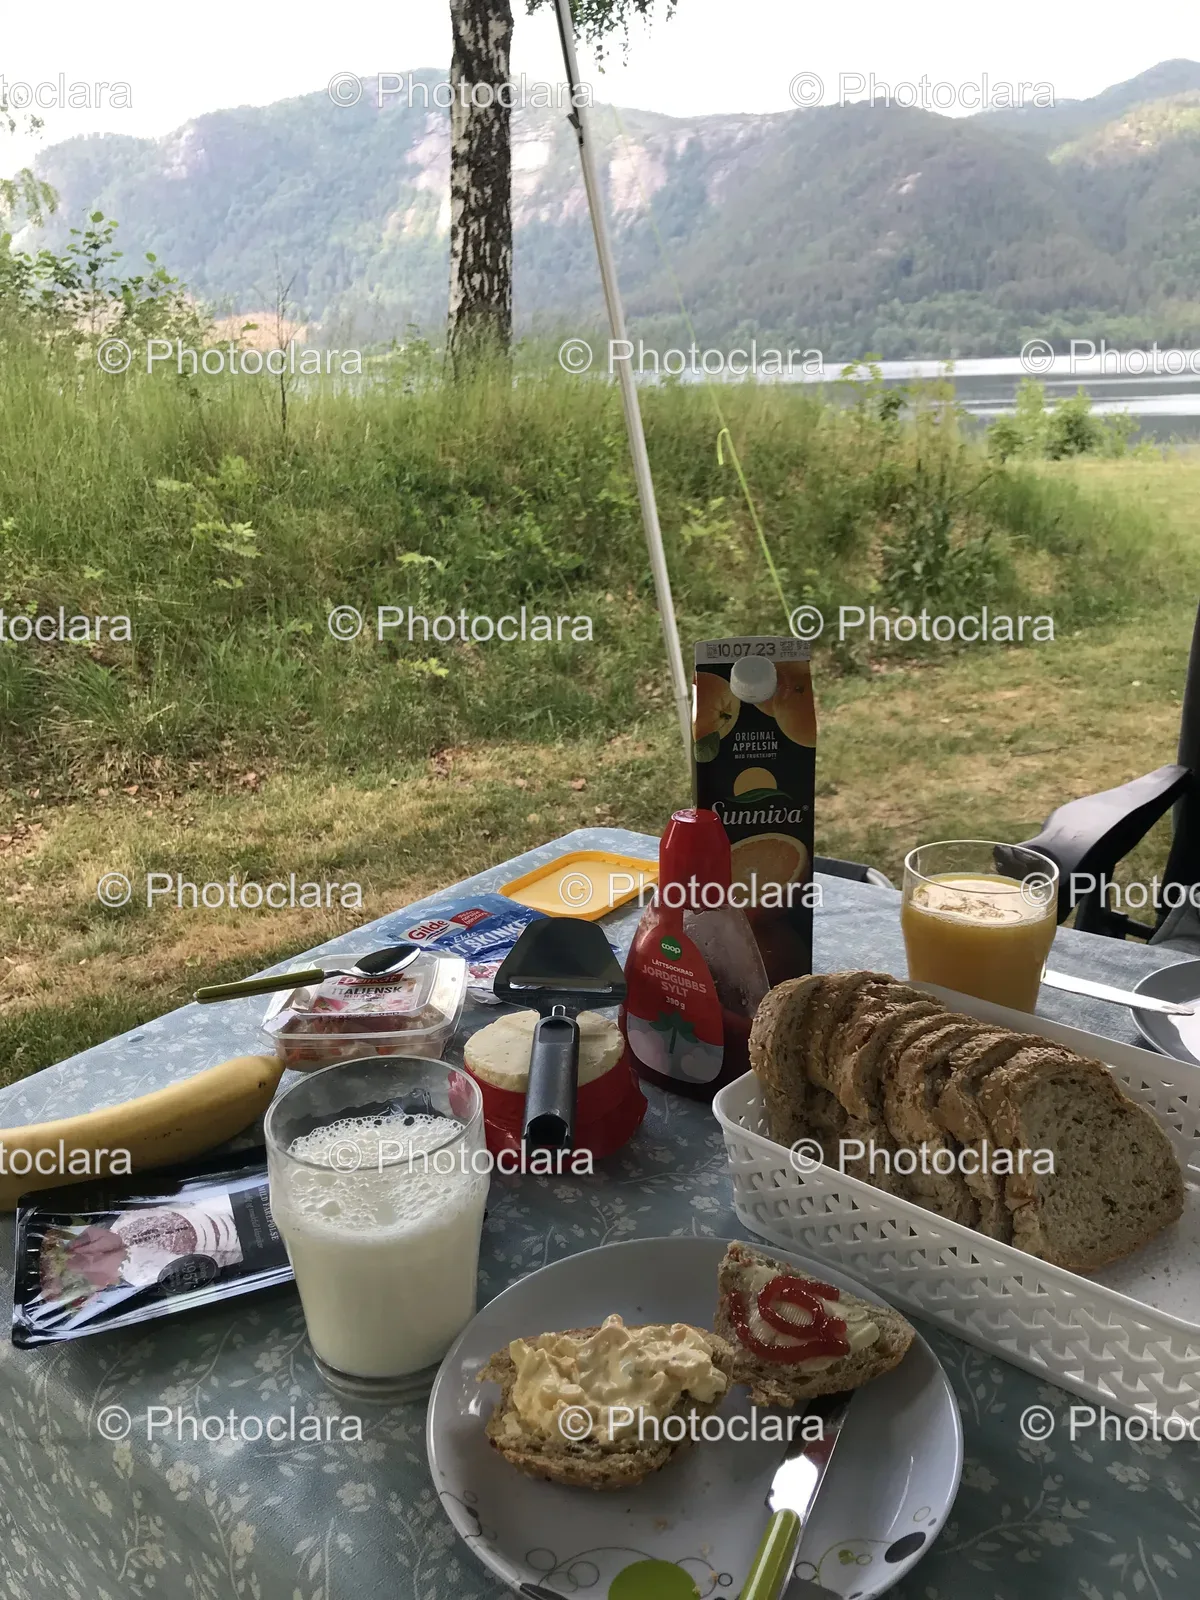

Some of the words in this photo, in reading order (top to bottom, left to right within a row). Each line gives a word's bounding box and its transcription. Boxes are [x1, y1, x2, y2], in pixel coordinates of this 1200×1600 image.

[735, 731, 776, 741] ORIGINAL
[732, 741, 779, 752] APPELSIN
[408, 919, 448, 941] Gilde
[464, 917, 528, 949] SKINKE
[661, 942, 681, 954] coop
[641, 964, 707, 994] JORDGUBBS
[661, 980, 689, 998] SYLT
[182, 1261, 200, 1285] 1957
